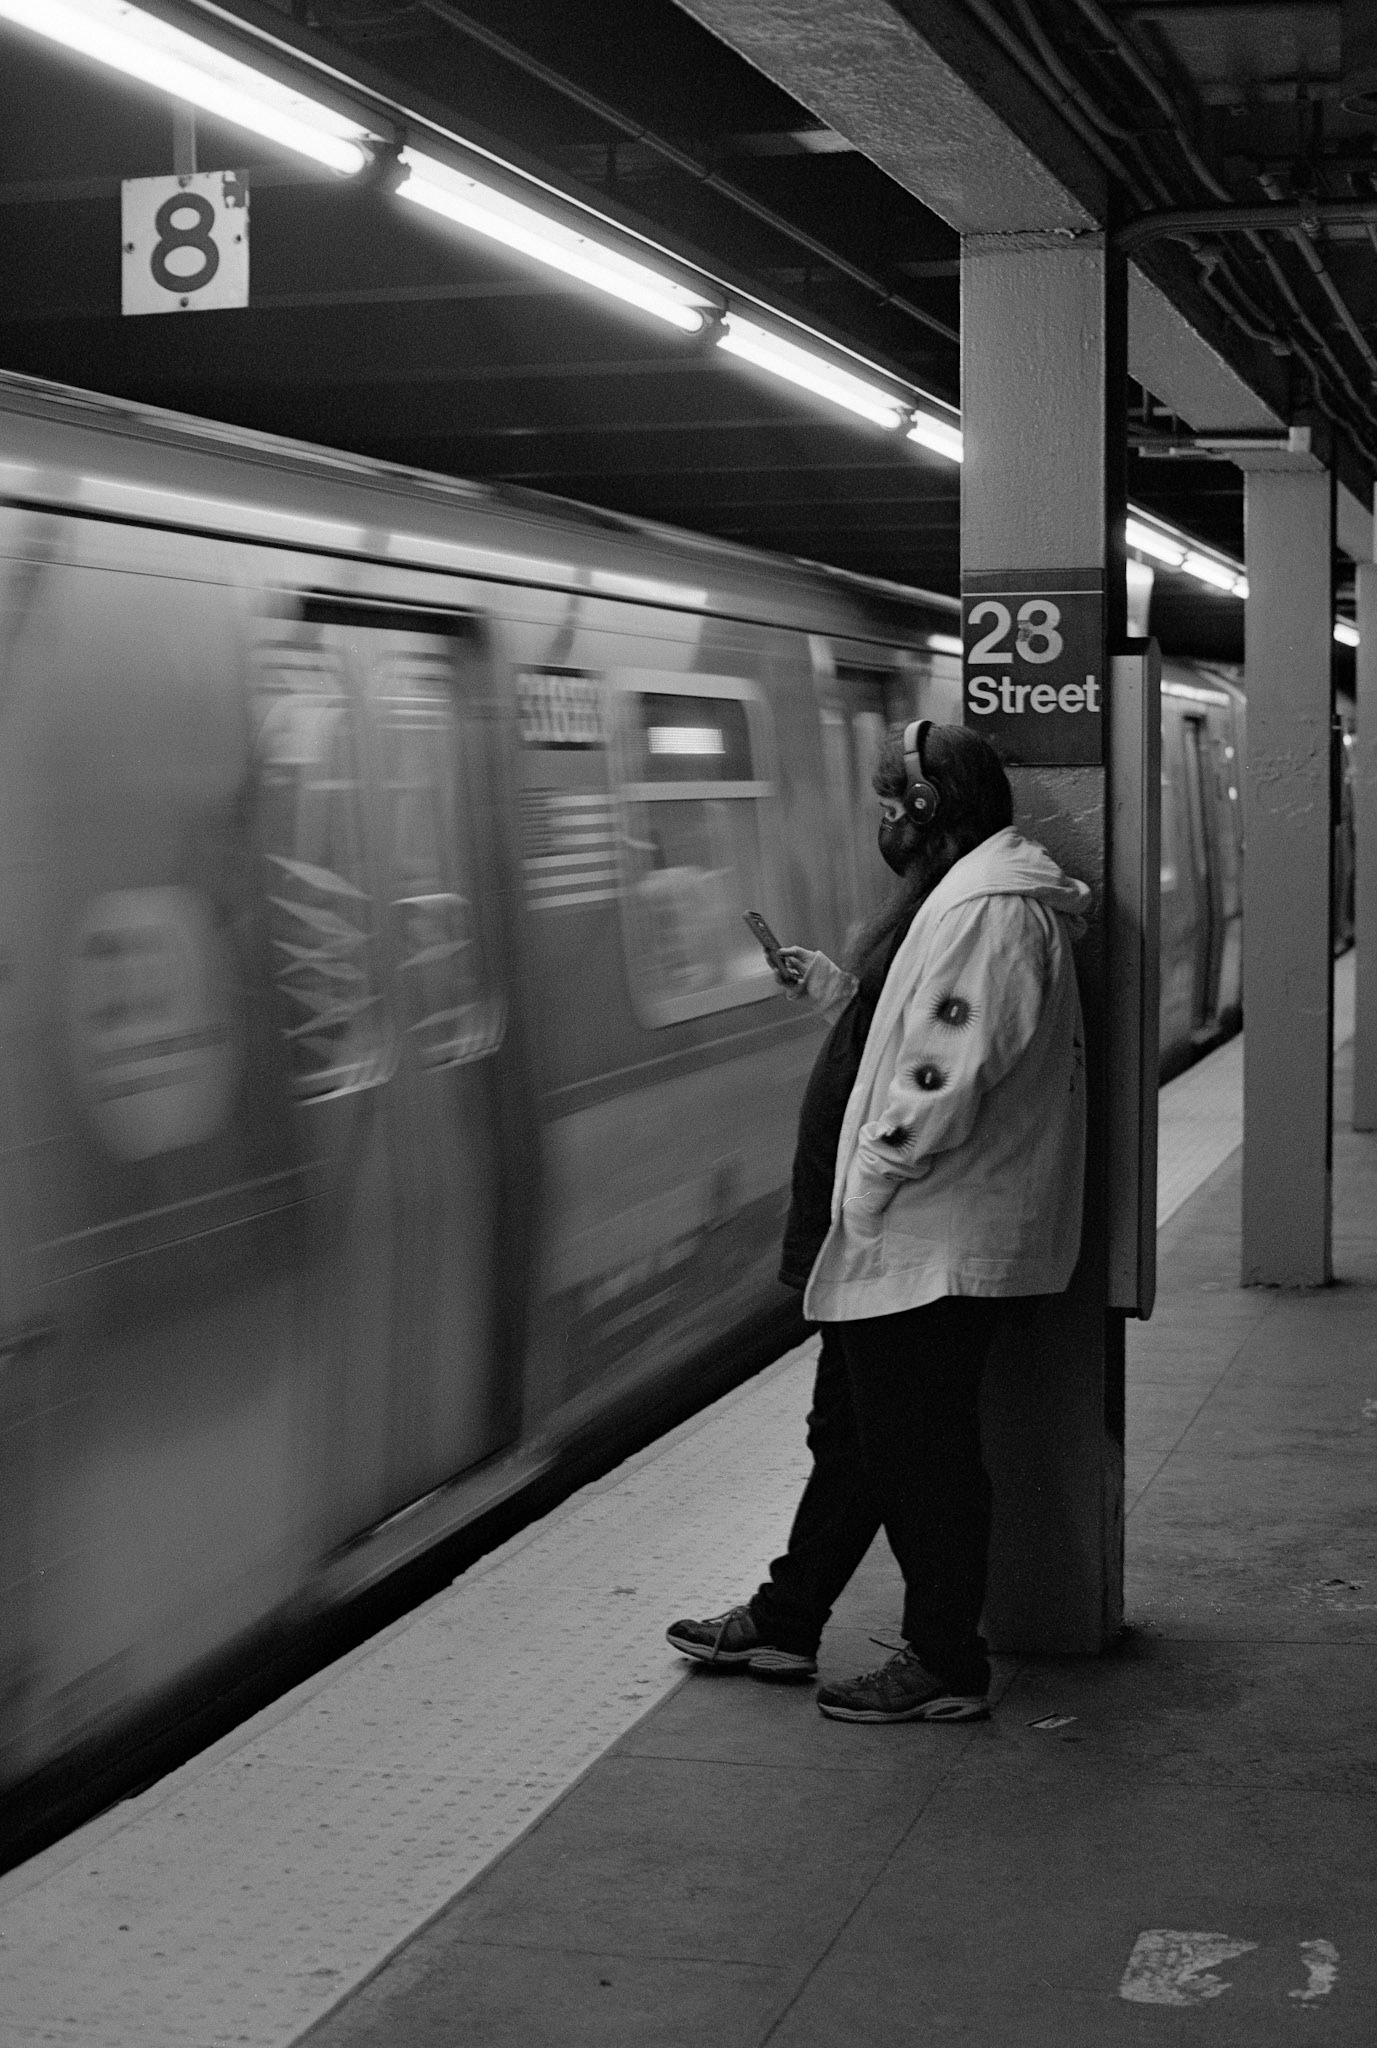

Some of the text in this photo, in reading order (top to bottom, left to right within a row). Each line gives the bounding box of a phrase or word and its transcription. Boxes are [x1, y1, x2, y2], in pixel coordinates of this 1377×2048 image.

[151, 192, 220, 293] 8
[967, 599, 1064, 664] 28
[967, 674, 1101, 715] Street
